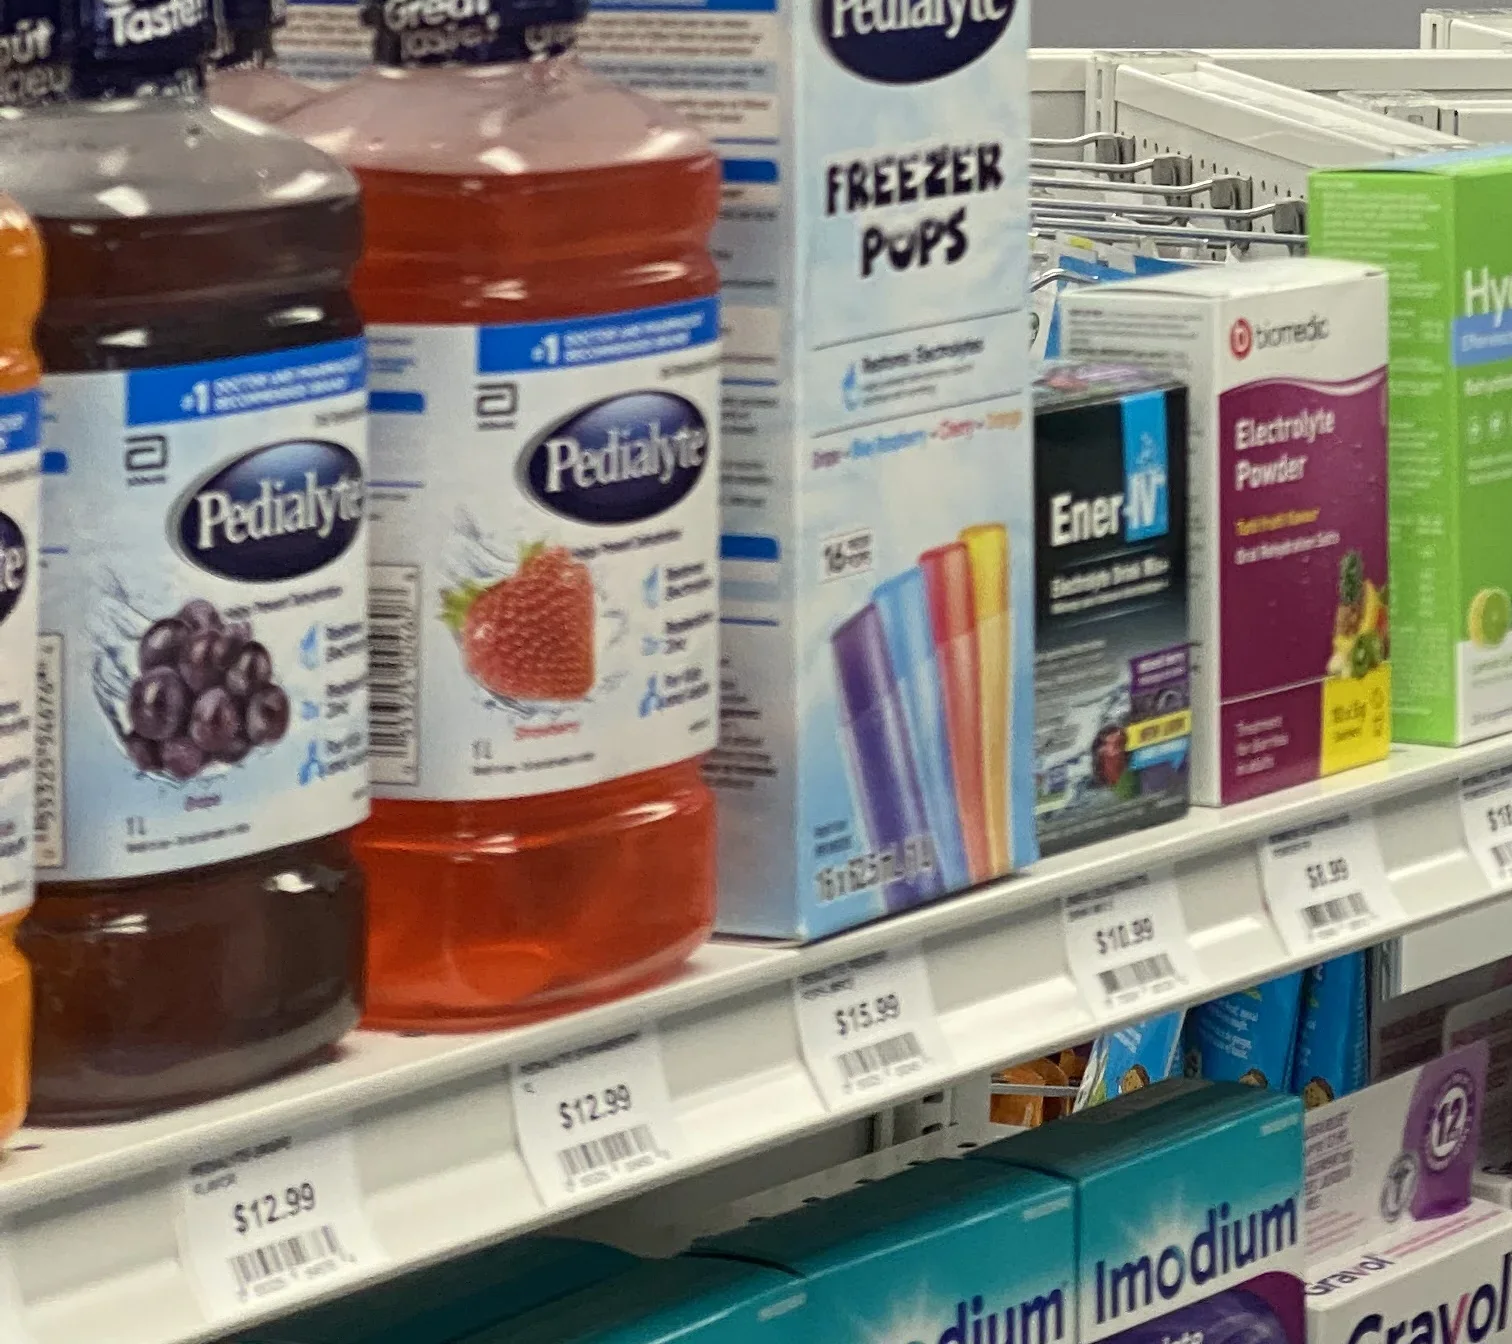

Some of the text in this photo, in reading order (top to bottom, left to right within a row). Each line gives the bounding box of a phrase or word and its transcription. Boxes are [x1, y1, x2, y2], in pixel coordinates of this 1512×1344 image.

[824, 140, 1006, 216] FREEZER
[860, 207, 968, 280] POPS
[1254, 312, 1330, 350] biomedic
[543, 416, 707, 494] Pedialyte
[1234, 408, 1336, 451] Electrolyte
[1234, 452, 1309, 492] Powder
[198, 470, 366, 549] Pedialyte
[834, 993, 900, 1037] $15.99
[558, 1082, 632, 1131] $12.99
[232, 1181, 317, 1236] $12.99
[1096, 1197, 1298, 1325] Imodium
[1305, 1251, 1396, 1297] Gravol
